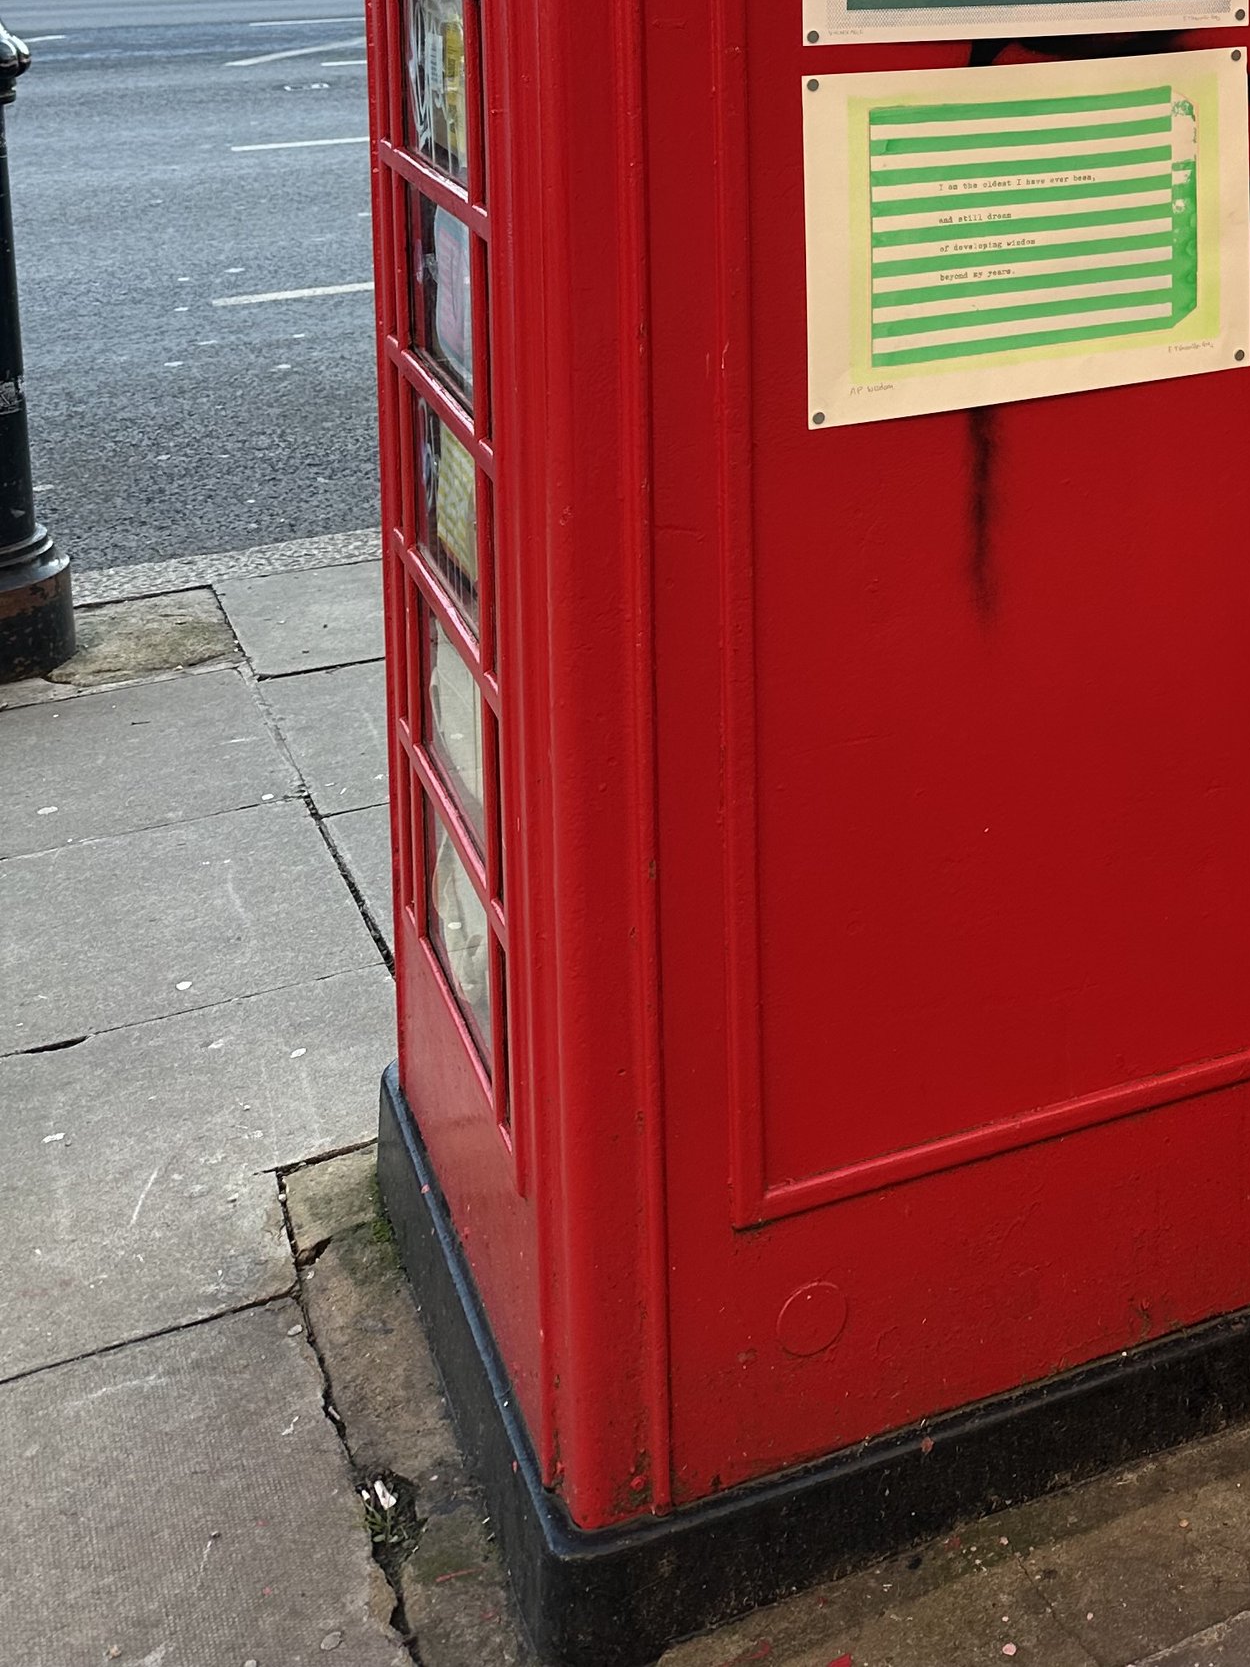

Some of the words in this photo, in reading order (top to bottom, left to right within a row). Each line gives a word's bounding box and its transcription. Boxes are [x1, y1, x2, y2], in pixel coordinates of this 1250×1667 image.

[938, 183, 943, 191] I
[963, 182, 977, 190] the
[983, 180, 1012, 189] oldest
[1026, 177, 1045, 185] have
[1073, 174, 1096, 182] been,
[939, 216, 953, 224] and
[958, 213, 983, 222] still
[987, 212, 1012, 220] dream
[940, 245, 949, 253] of
[953, 241, 1002, 252] developing
[1007, 238, 1036, 246] wisdom
[940, 271, 969, 281] beyond
[973, 271, 983, 279] my
[987, 269, 1016, 278] years.
